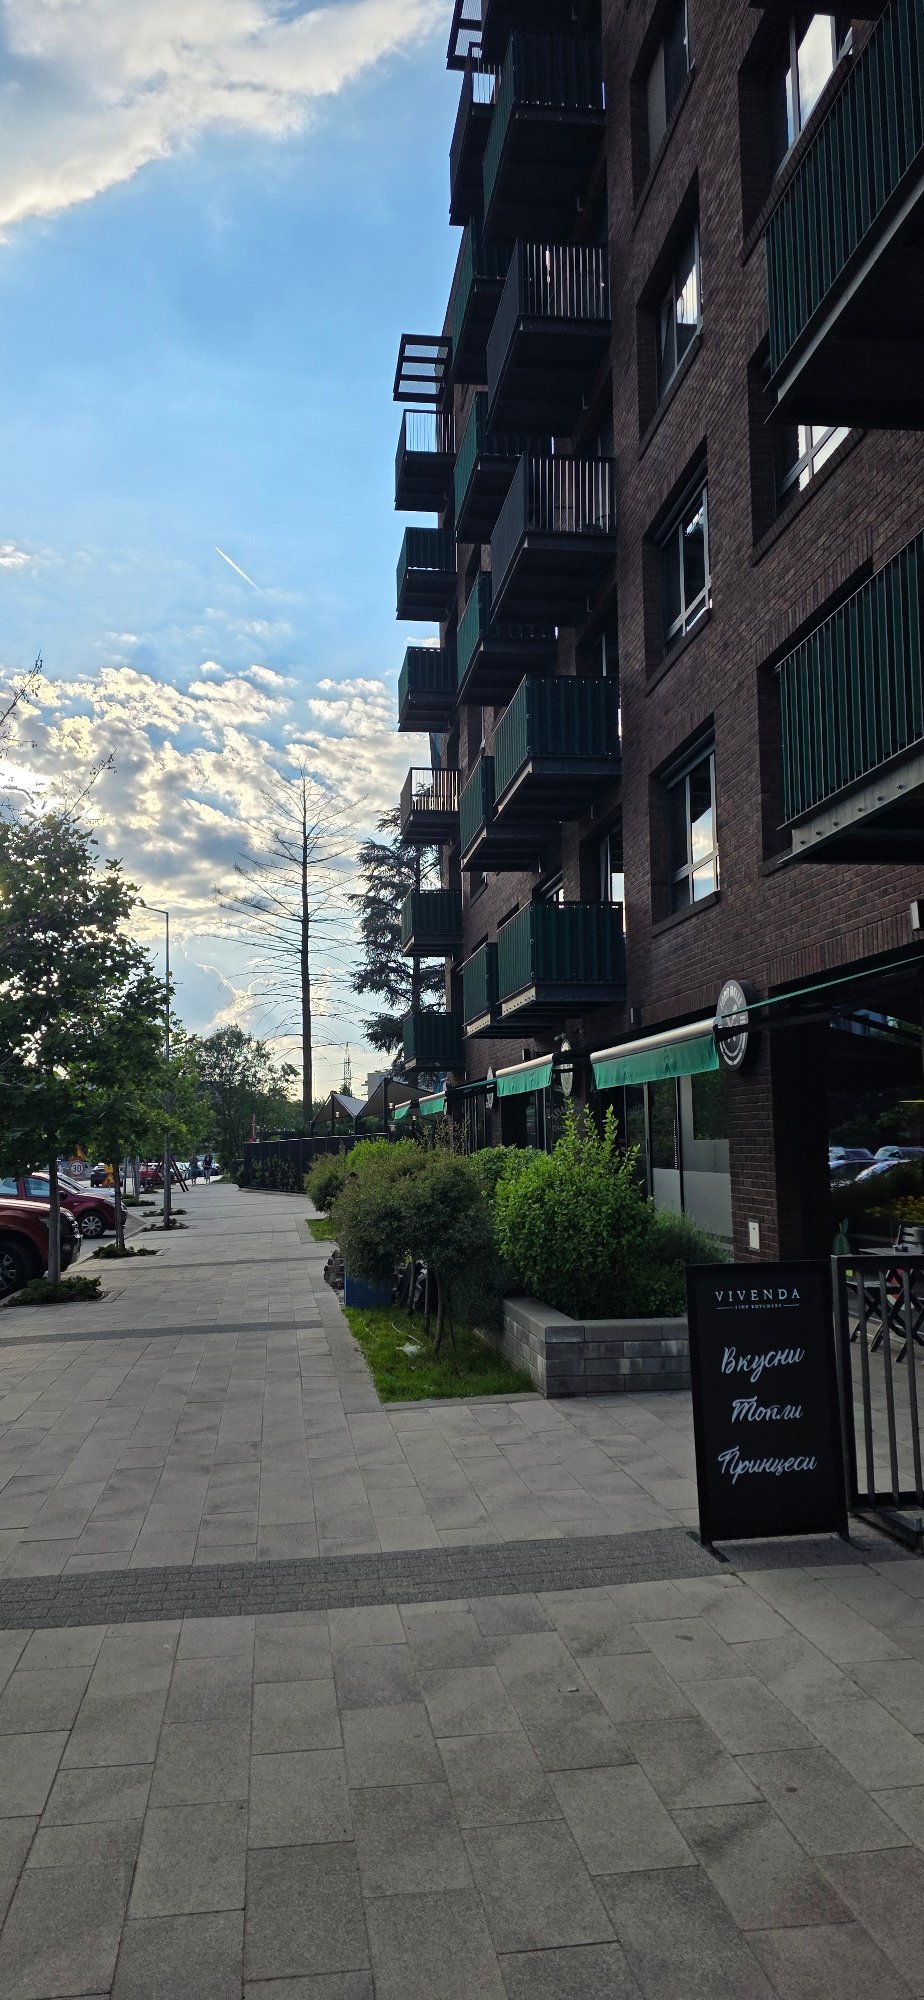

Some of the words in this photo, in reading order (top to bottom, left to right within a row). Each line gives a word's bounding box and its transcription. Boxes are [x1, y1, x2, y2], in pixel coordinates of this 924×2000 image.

[72, 1164, 82, 1173] 30
[714, 1288, 800, 1302] VIVENDA
[721, 1346, 805, 1383] Вкусни
[731, 1395, 804, 1424] Топли
[717, 1445, 817, 1485] Принцеси
